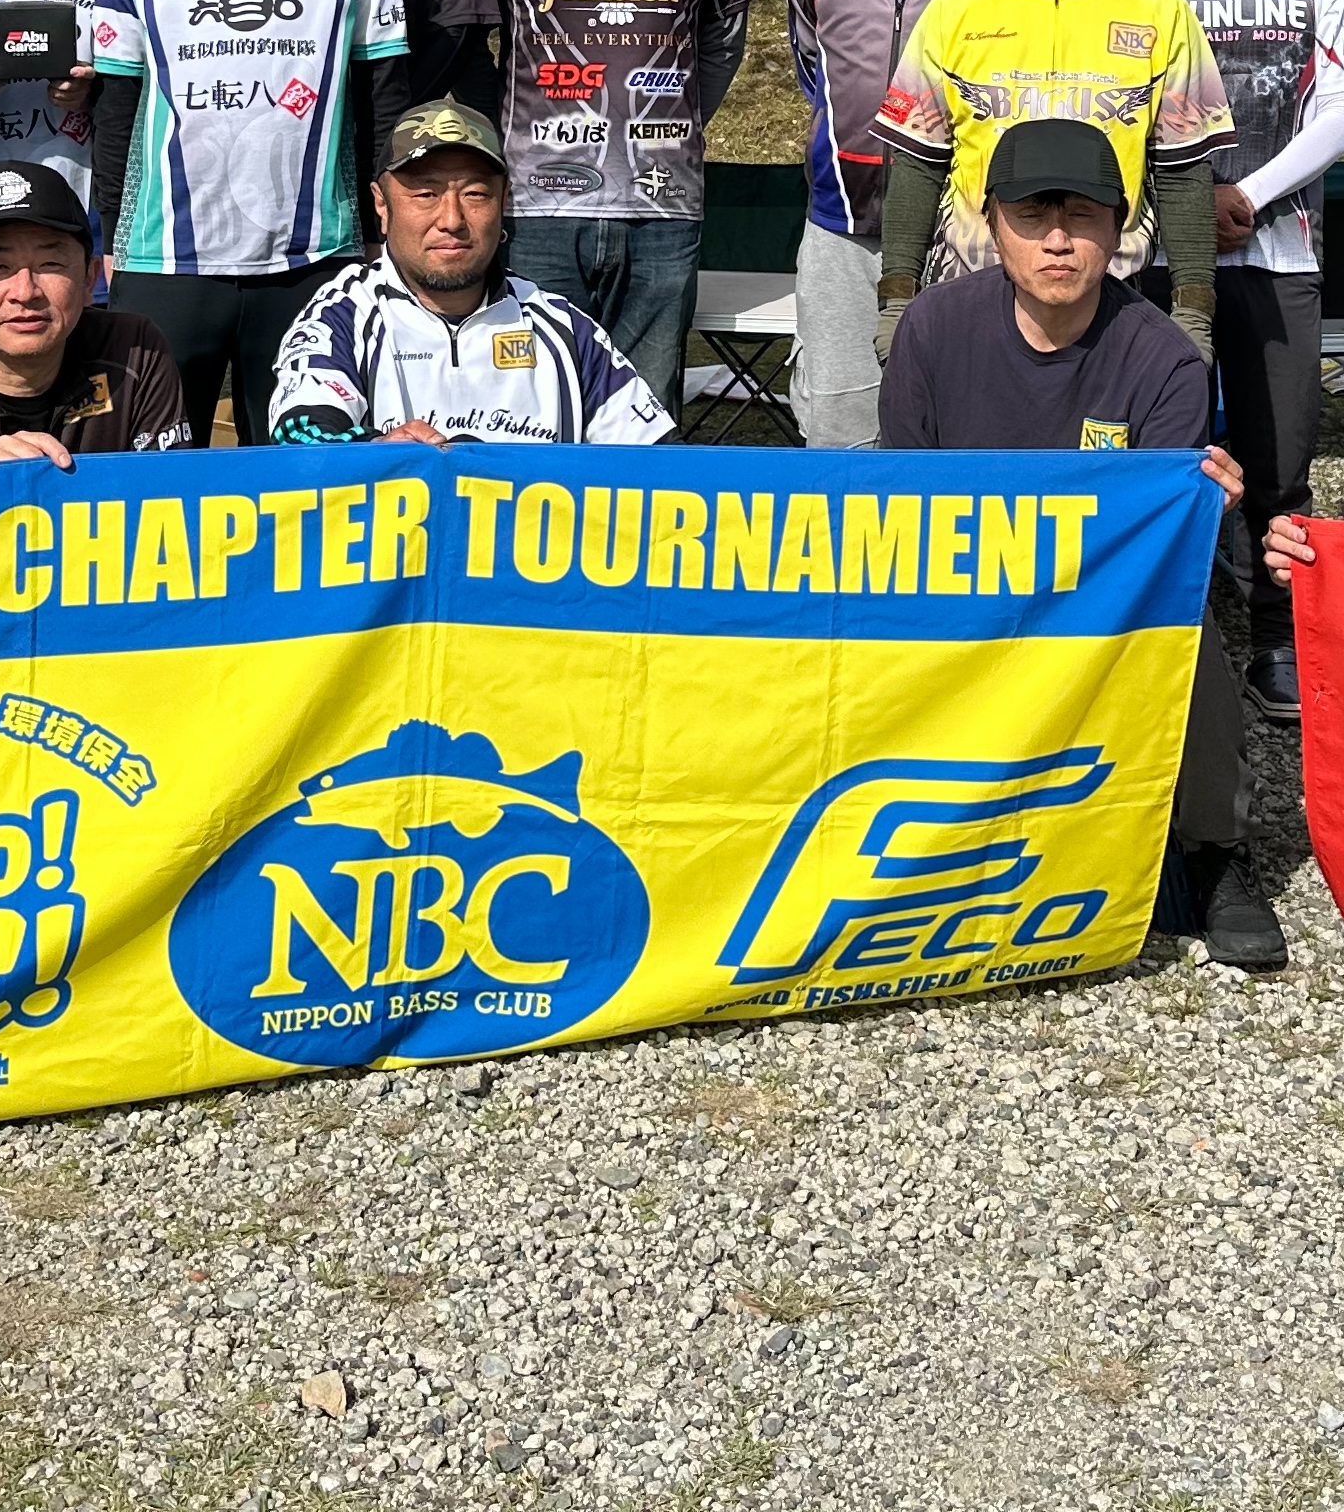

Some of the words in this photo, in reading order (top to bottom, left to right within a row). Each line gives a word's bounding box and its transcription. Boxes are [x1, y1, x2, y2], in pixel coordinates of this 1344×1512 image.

[1193, 0, 1307, 30] UNLINE
[4, 41, 48, 53] Garcia
[22, 31, 48, 42] Abu
[533, 33, 575, 45] FEEL
[1113, 28, 1152, 50] NBC
[1207, 30, 1241, 42] ALIST
[537, 64, 607, 87] SDG
[545, 89, 593, 99] MARINE
[988, 86, 1124, 120] BAGUS
[629, 122, 690, 139] KEITECH
[530, 175, 554, 186] Sight
[446, 410, 484, 431] out!
[1084, 427, 1126, 450] NBC
[455, 475, 1098, 595] TOURNAMENT
[250, 854, 571, 999] NBC
[984, 953, 1086, 983] ECOLOGY
[261, 999, 376, 1037] NIPPON
[388, 990, 459, 1019] BASS
[475, 989, 553, 1019] CLUB
